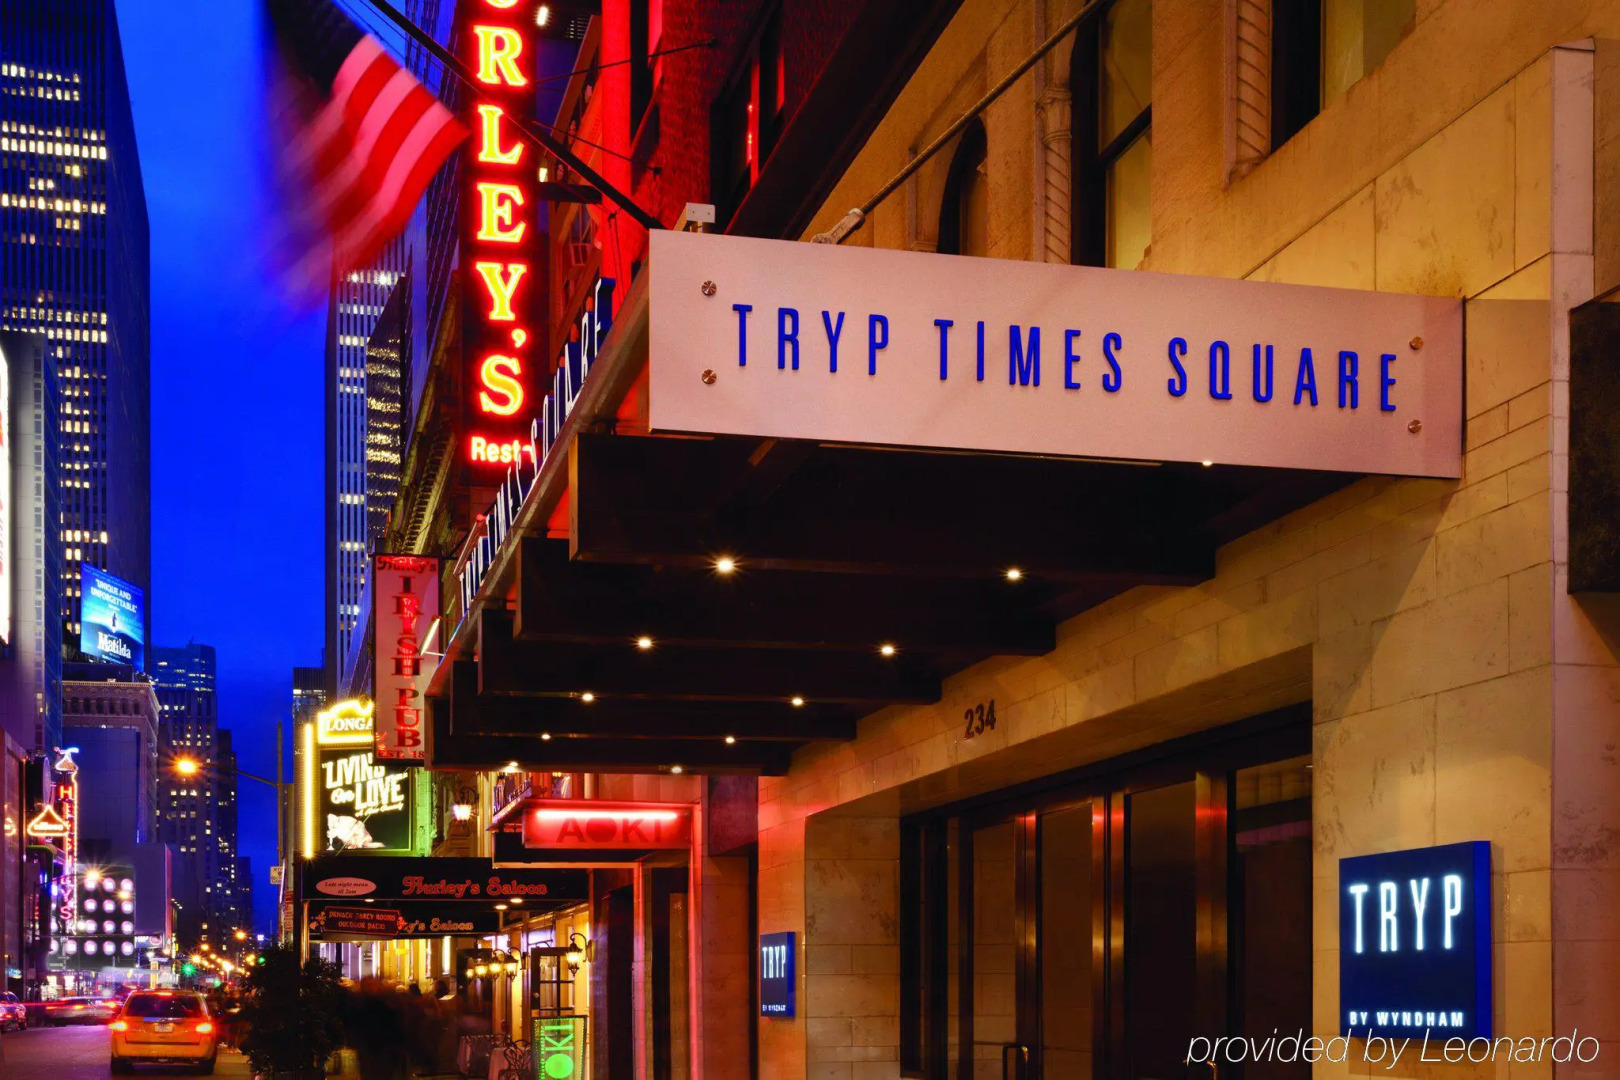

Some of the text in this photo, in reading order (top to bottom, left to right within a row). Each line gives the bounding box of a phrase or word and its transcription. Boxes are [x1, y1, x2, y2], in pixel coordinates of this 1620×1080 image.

[732, 303, 1397, 412] TRYP TIMES SQUARE
[391, 576, 423, 676] IRISH
[97, 631, 132, 659] Matilda
[393, 687, 423, 747] PUB
[964, 699, 997, 740] 234
[556, 816, 661, 843] AOKI
[402, 876, 547, 898] Hurley's Saloon
[375, 914, 396, 922] ROOMS
[430, 917, 474, 932] Saloon
[1348, 874, 1463, 955] TRYP
[762, 945, 786, 979] TRYP
[1349, 1011, 1464, 1028] BY WYNDHAM
